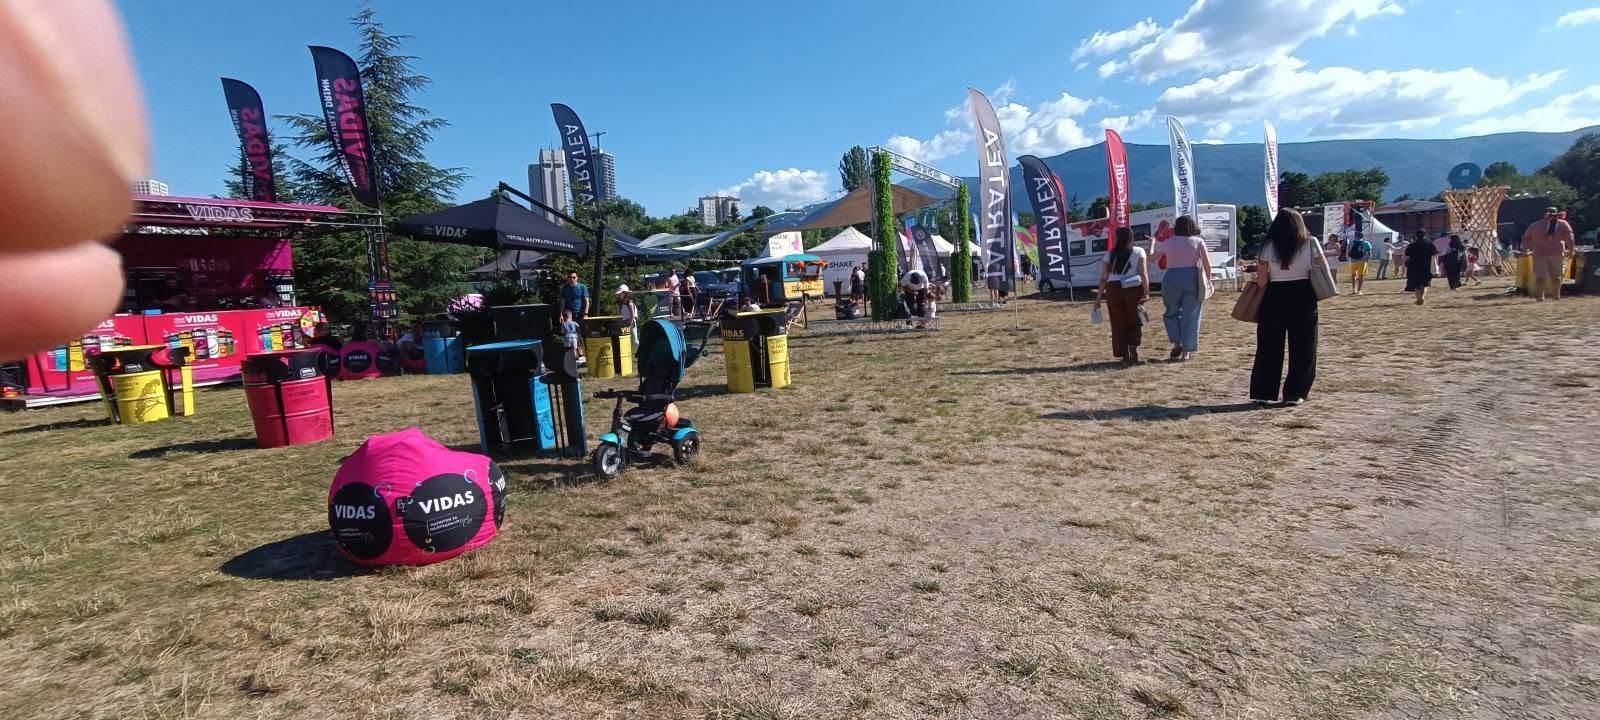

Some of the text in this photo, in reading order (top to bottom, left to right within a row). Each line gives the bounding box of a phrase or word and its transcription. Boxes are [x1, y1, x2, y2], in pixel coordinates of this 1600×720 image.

[184, 204, 255, 223] VIDAS
[434, 224, 468, 239] VIDAS
[829, 260, 854, 269] SHAKE
[184, 314, 218, 323] VIDAS
[274, 309, 303, 318] VIDAS
[418, 490, 475, 514] VIDAS
[334, 504, 376, 520] VIDAS
